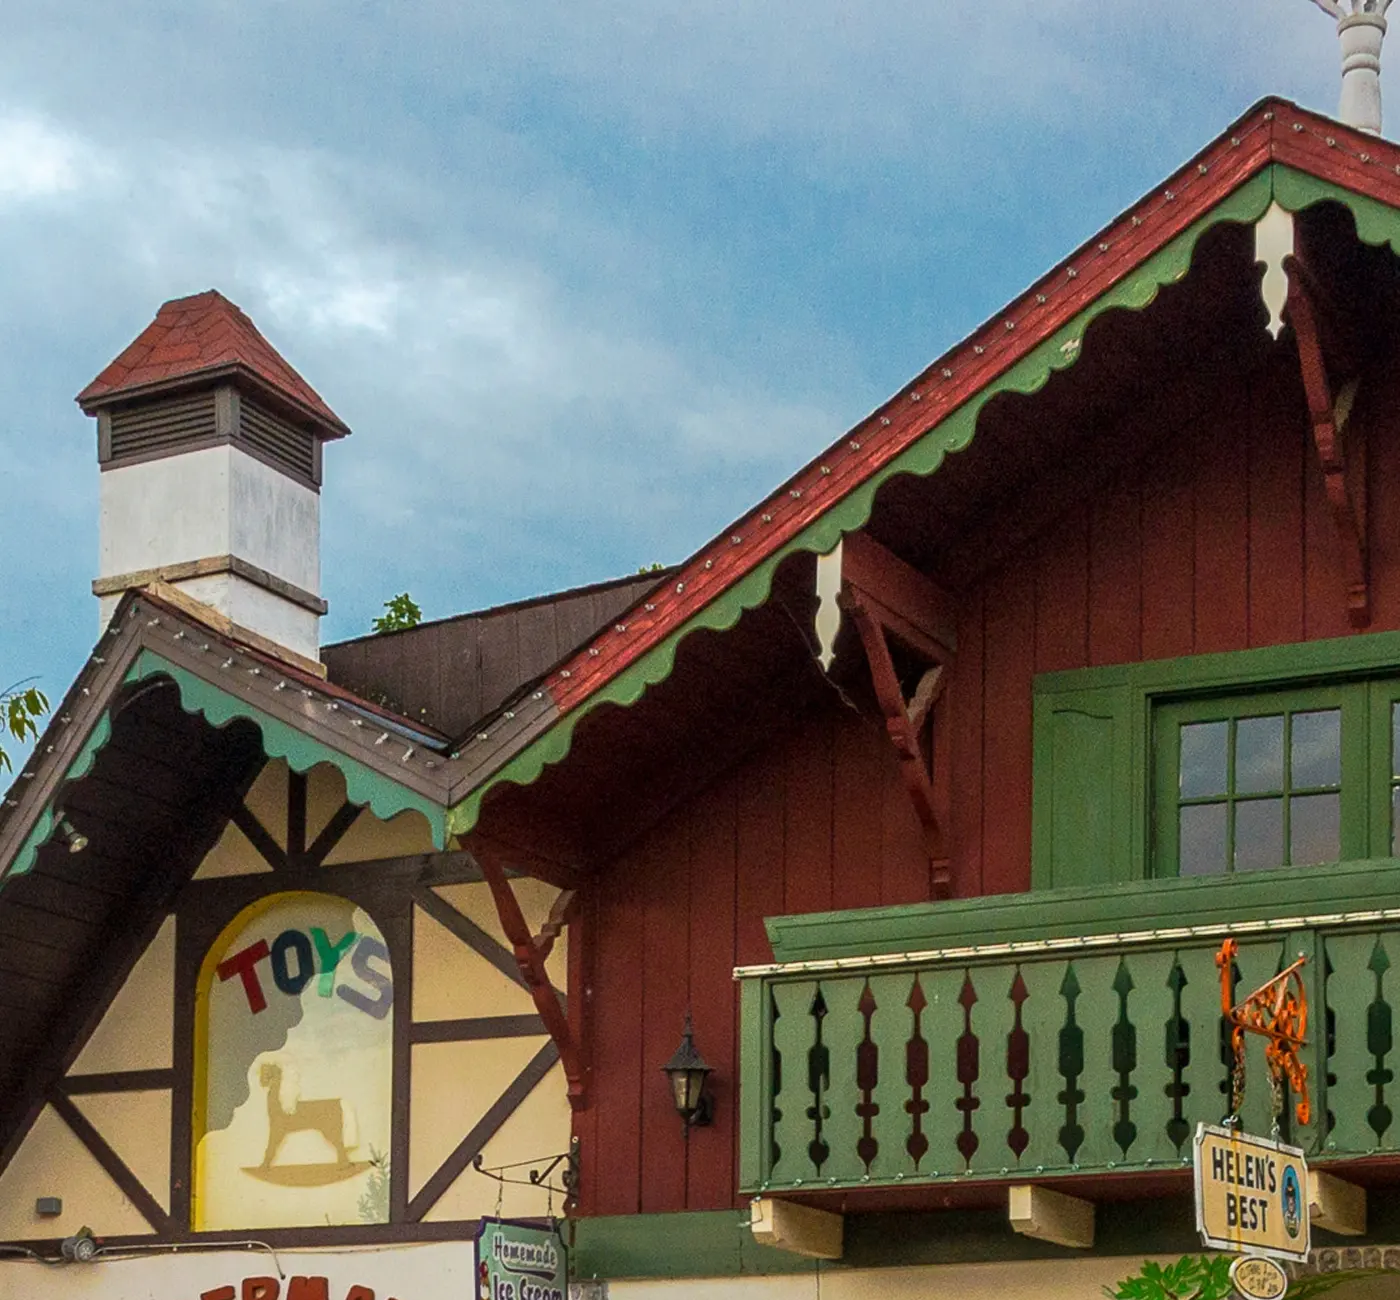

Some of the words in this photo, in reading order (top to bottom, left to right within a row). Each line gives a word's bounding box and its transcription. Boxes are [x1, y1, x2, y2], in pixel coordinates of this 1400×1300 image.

[215, 927, 394, 1020] TOYS
[1211, 1146, 1277, 1193] HELEN'S
[1226, 1192, 1268, 1233] BEST
[494, 1234, 556, 1266] Homemade
